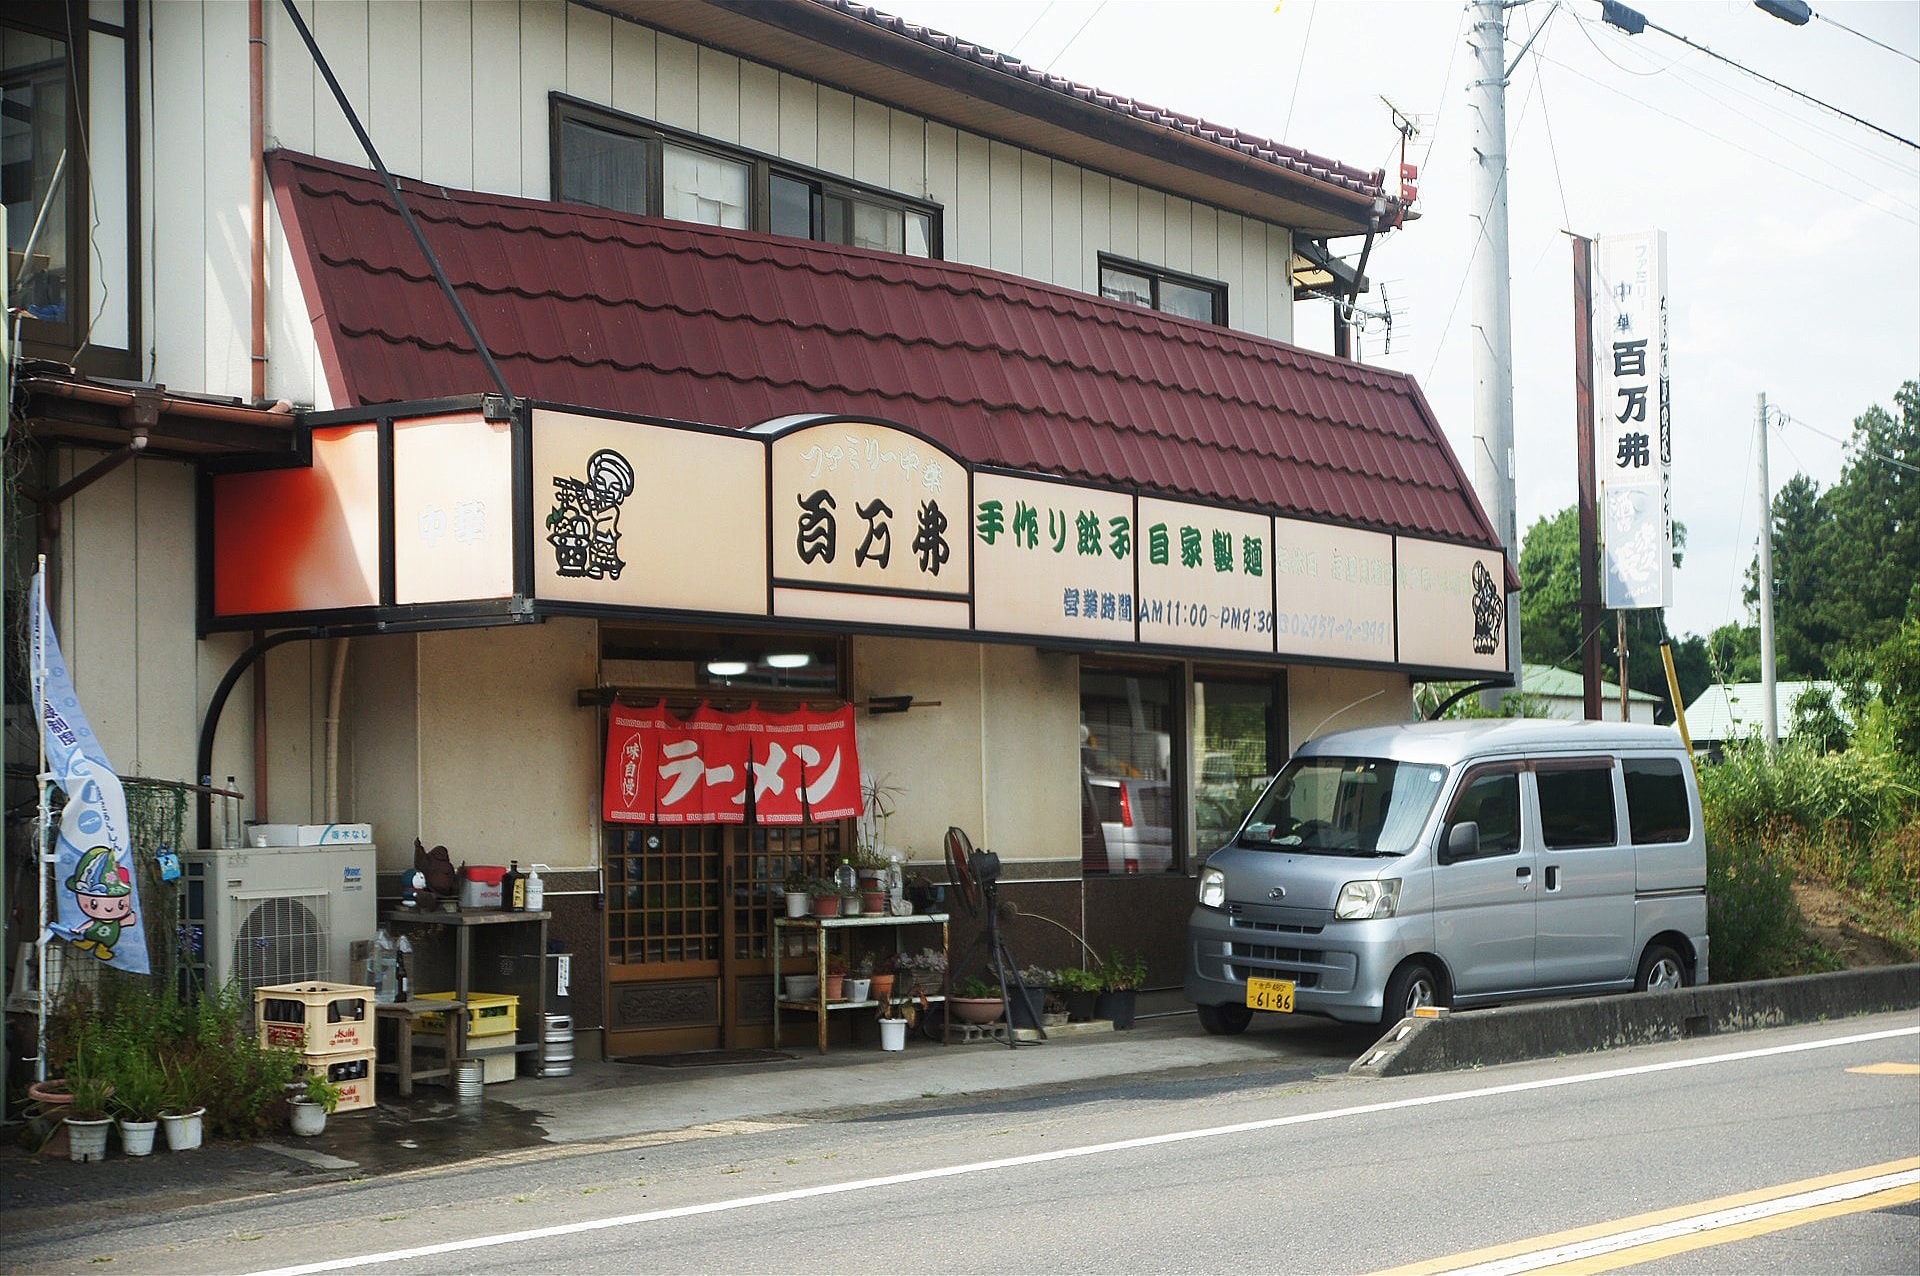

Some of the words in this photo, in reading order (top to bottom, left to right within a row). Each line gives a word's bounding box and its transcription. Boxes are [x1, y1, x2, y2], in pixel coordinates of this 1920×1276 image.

[1612, 338, 1651, 469] 百万弗
[417, 499, 491, 548] 中華
[796, 488, 951, 577] 百万弗
[975, 499, 1131, 561] 手作り餃子
[1148, 521, 1264, 578] 自家製麺
[1063, 587, 1133, 622] 営業時間
[622, 742, 640, 797] 味自慢
[659, 739, 842, 807] ラーメン
[1257, 992, 1290, 1010] 61-86
[335, 1027, 355, 1039] Asahi
